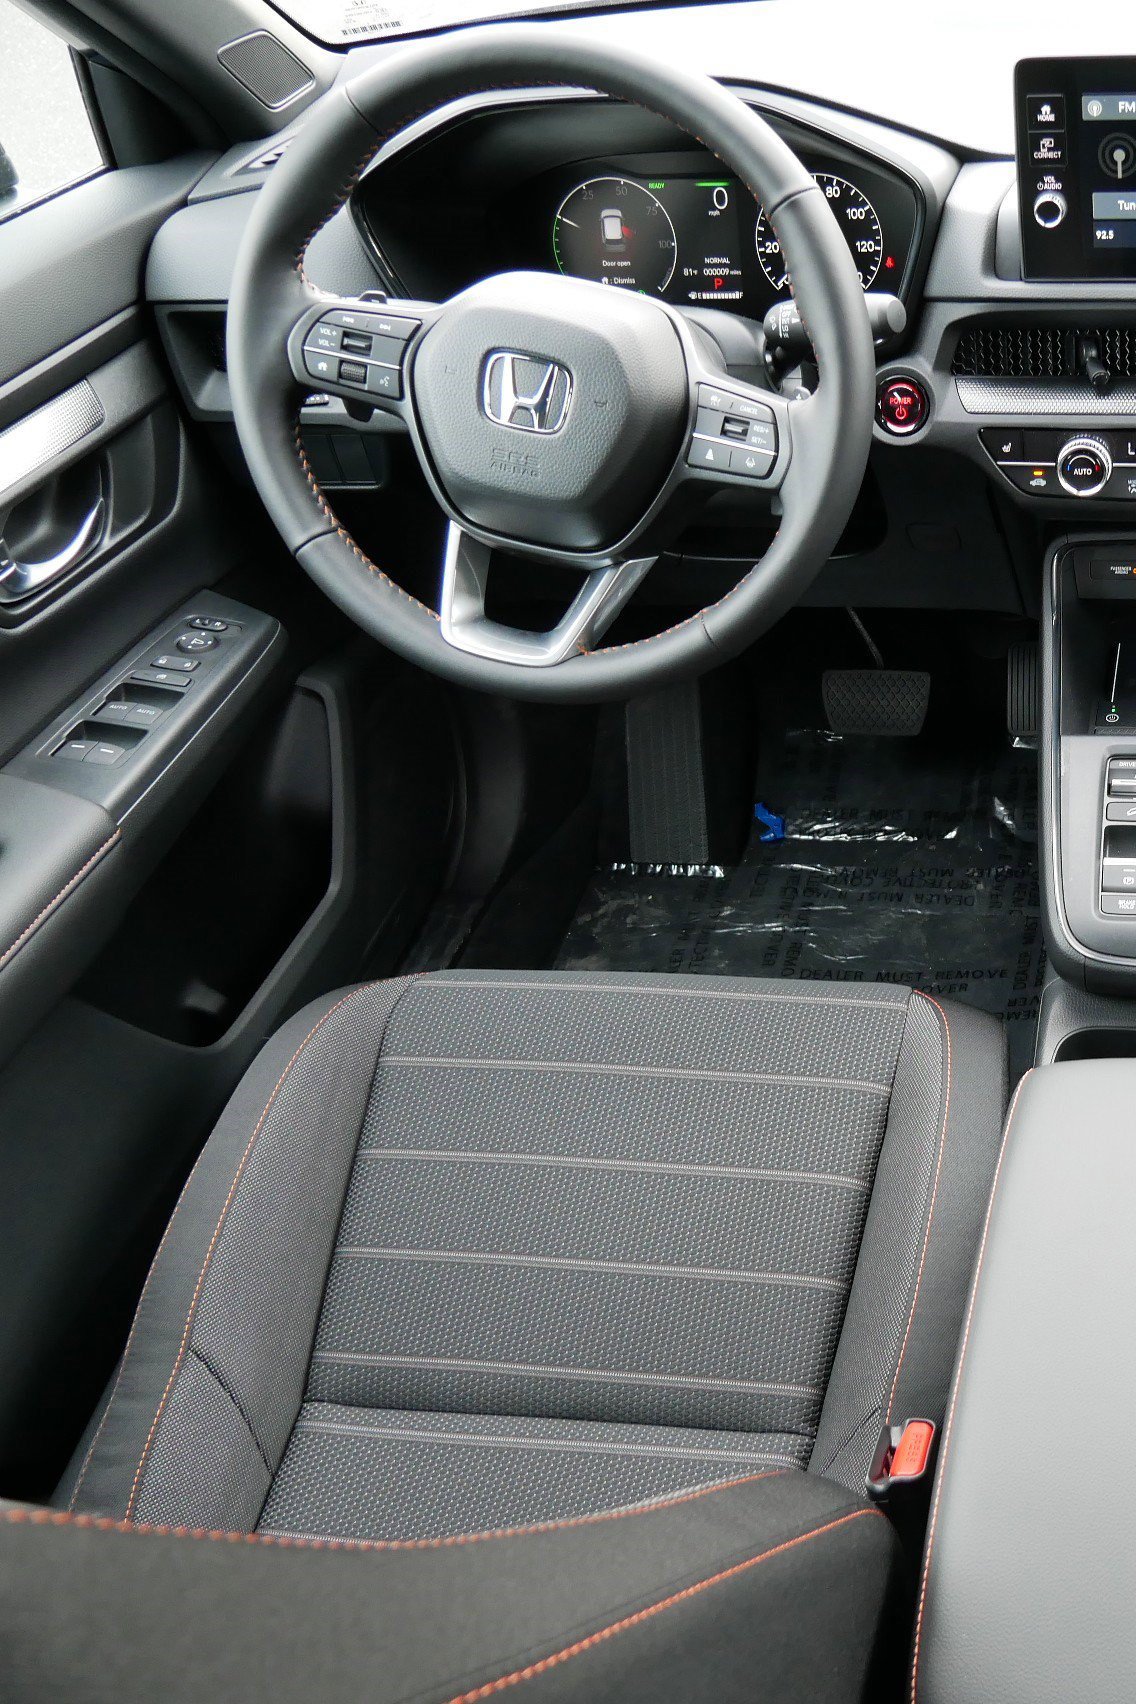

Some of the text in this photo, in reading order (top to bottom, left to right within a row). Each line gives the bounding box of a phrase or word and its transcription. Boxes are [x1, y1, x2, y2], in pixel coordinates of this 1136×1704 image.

[1118, 101, 1136, 113] FM
[1034, 151, 1062, 159] CONNECT
[826, 186, 840, 198] 80
[713, 187, 728, 210] 0
[846, 208, 866, 220] 100
[1096, 230, 1114, 240] 92.5
[765, 242, 780, 254] 20
[856, 242, 874, 252] 120
[703, 268, 730, 276] 000009
[714, 278, 723, 290] P
[740, 405, 758, 415] CANCEL
